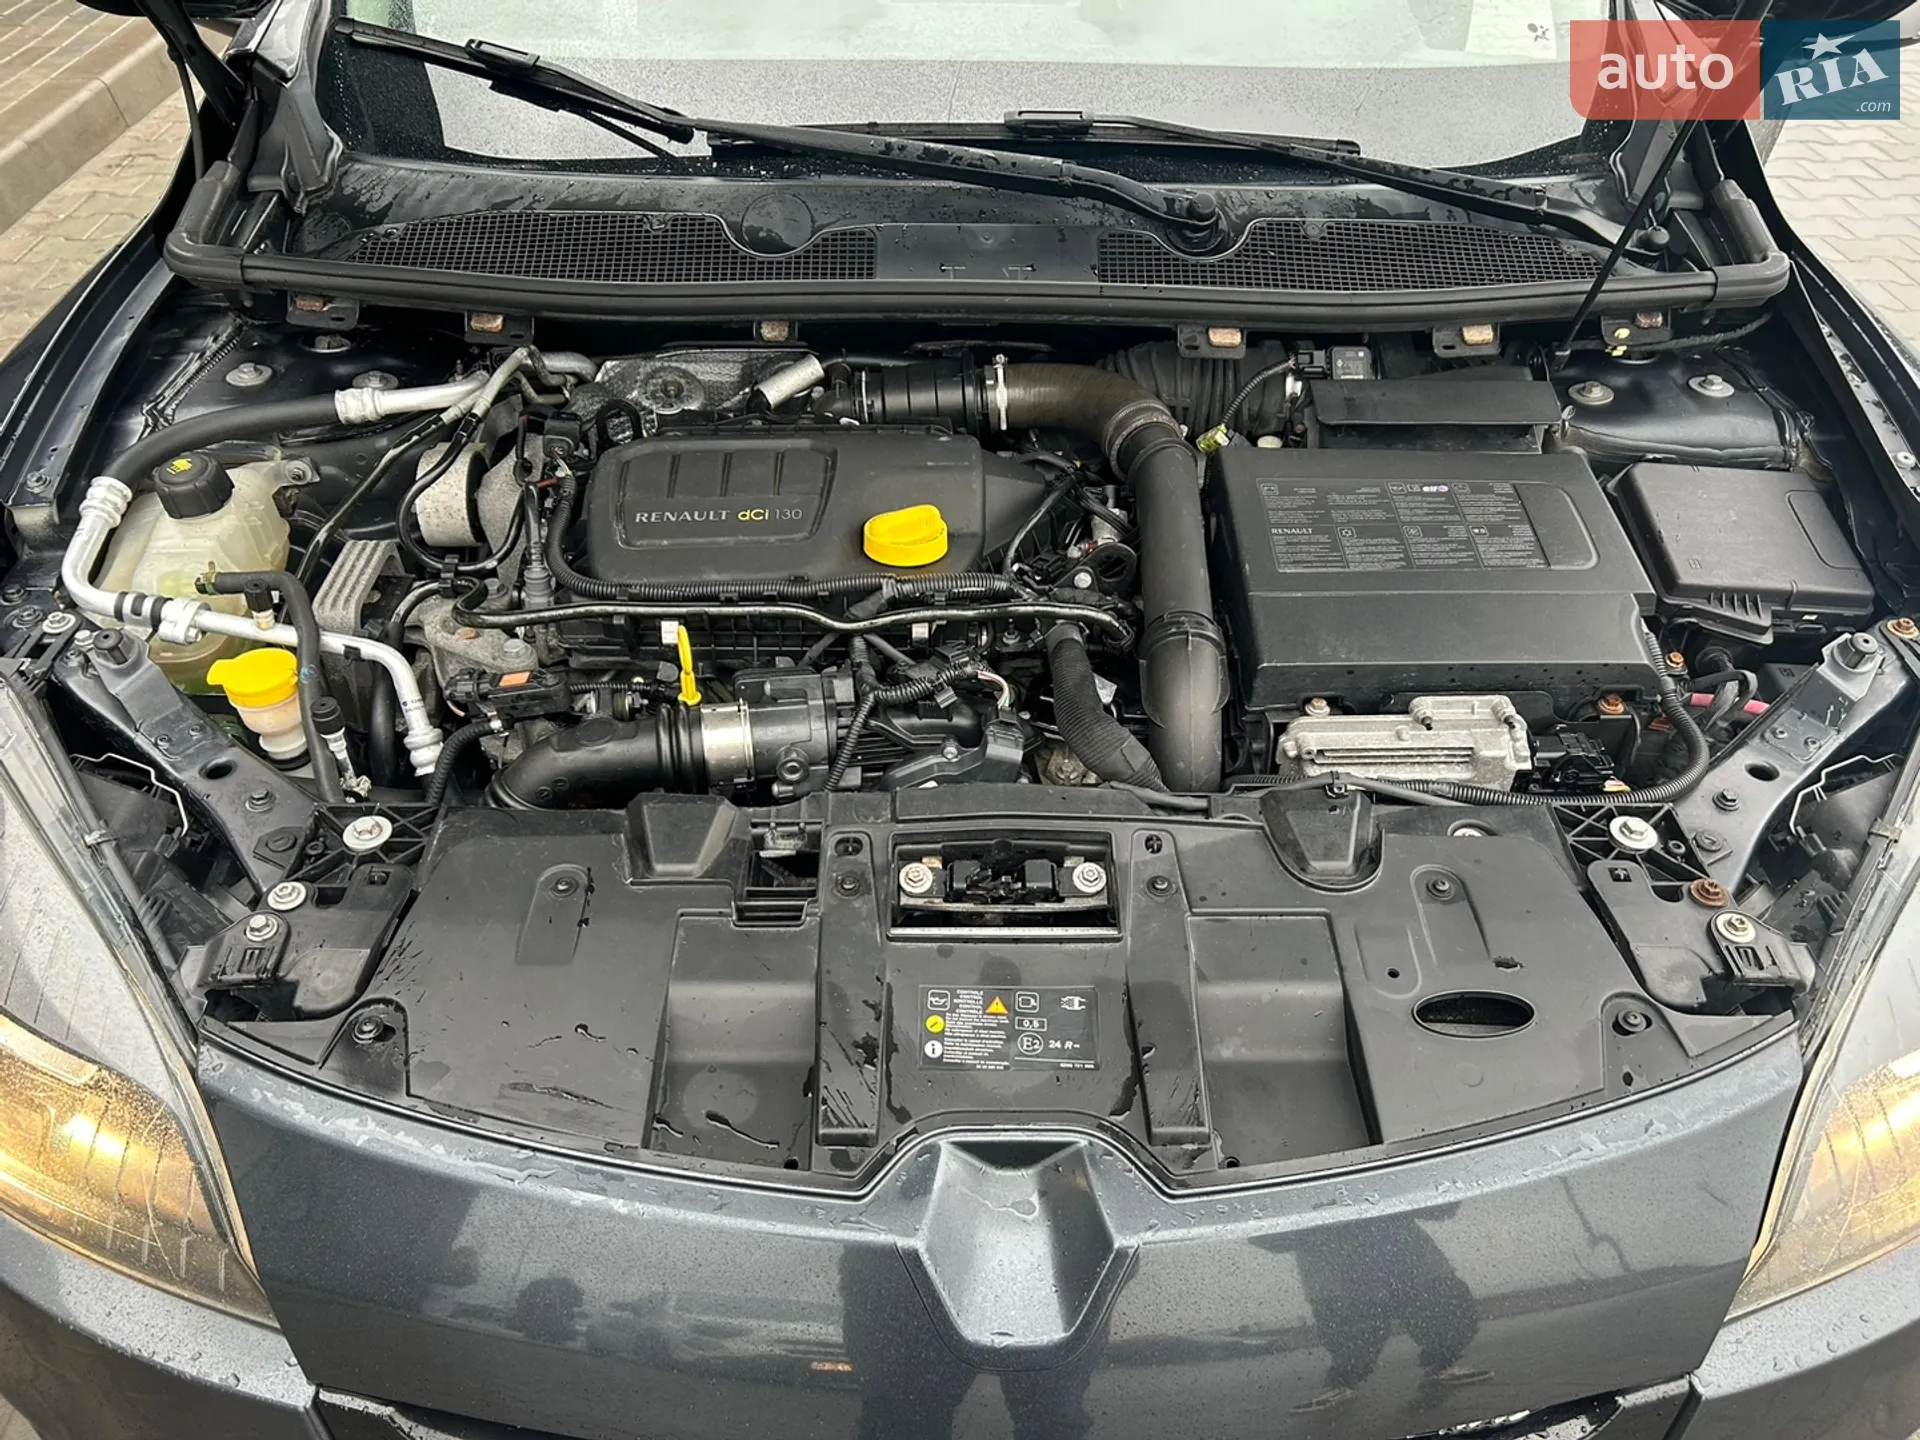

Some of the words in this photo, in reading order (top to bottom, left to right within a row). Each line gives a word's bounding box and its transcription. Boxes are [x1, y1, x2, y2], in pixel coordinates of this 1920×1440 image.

[635, 510, 730, 523] RENAULT
[737, 509, 769, 521] dCi
[774, 509, 803, 520] 130
[1271, 527, 1313, 535] RENAULT
[1022, 1037, 1040, 1051] E2
[1048, 1040, 1061, 1049] 24
